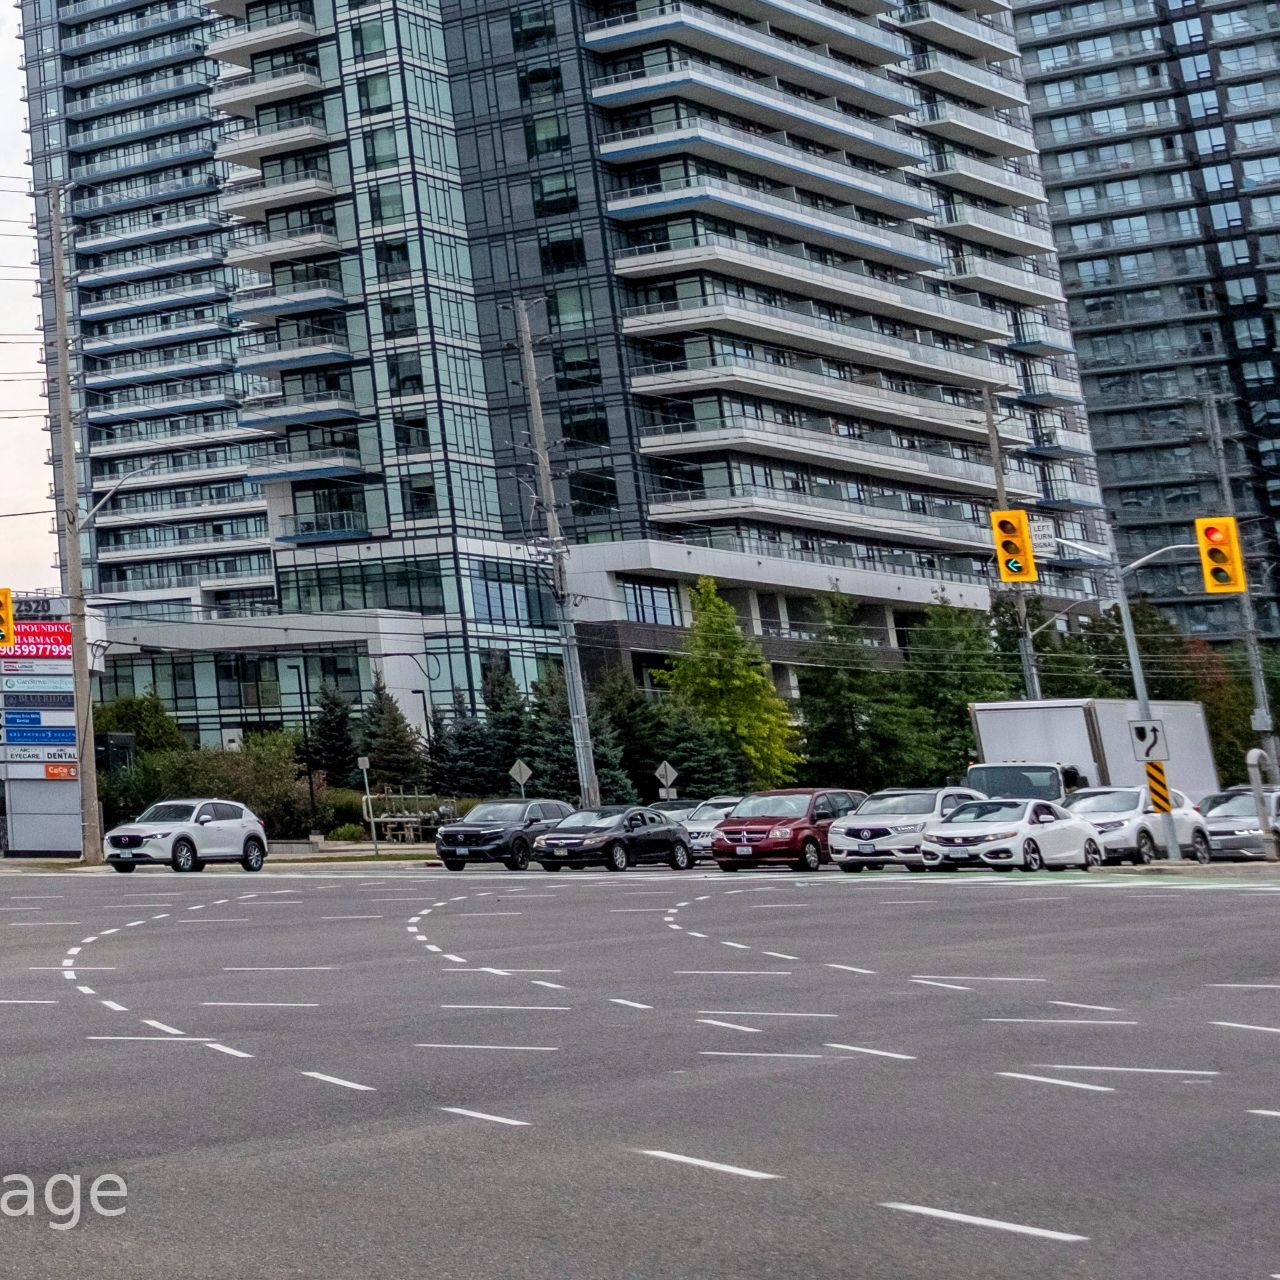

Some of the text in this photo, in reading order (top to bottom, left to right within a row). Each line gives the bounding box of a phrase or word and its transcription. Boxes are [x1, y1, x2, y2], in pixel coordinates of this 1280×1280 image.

[16, 600, 51, 613] 2520
[13, 624, 72, 632] MPOUNDING
[14, 635, 64, 644] HARMACY
[47, 752, 78, 760] DENTAL
